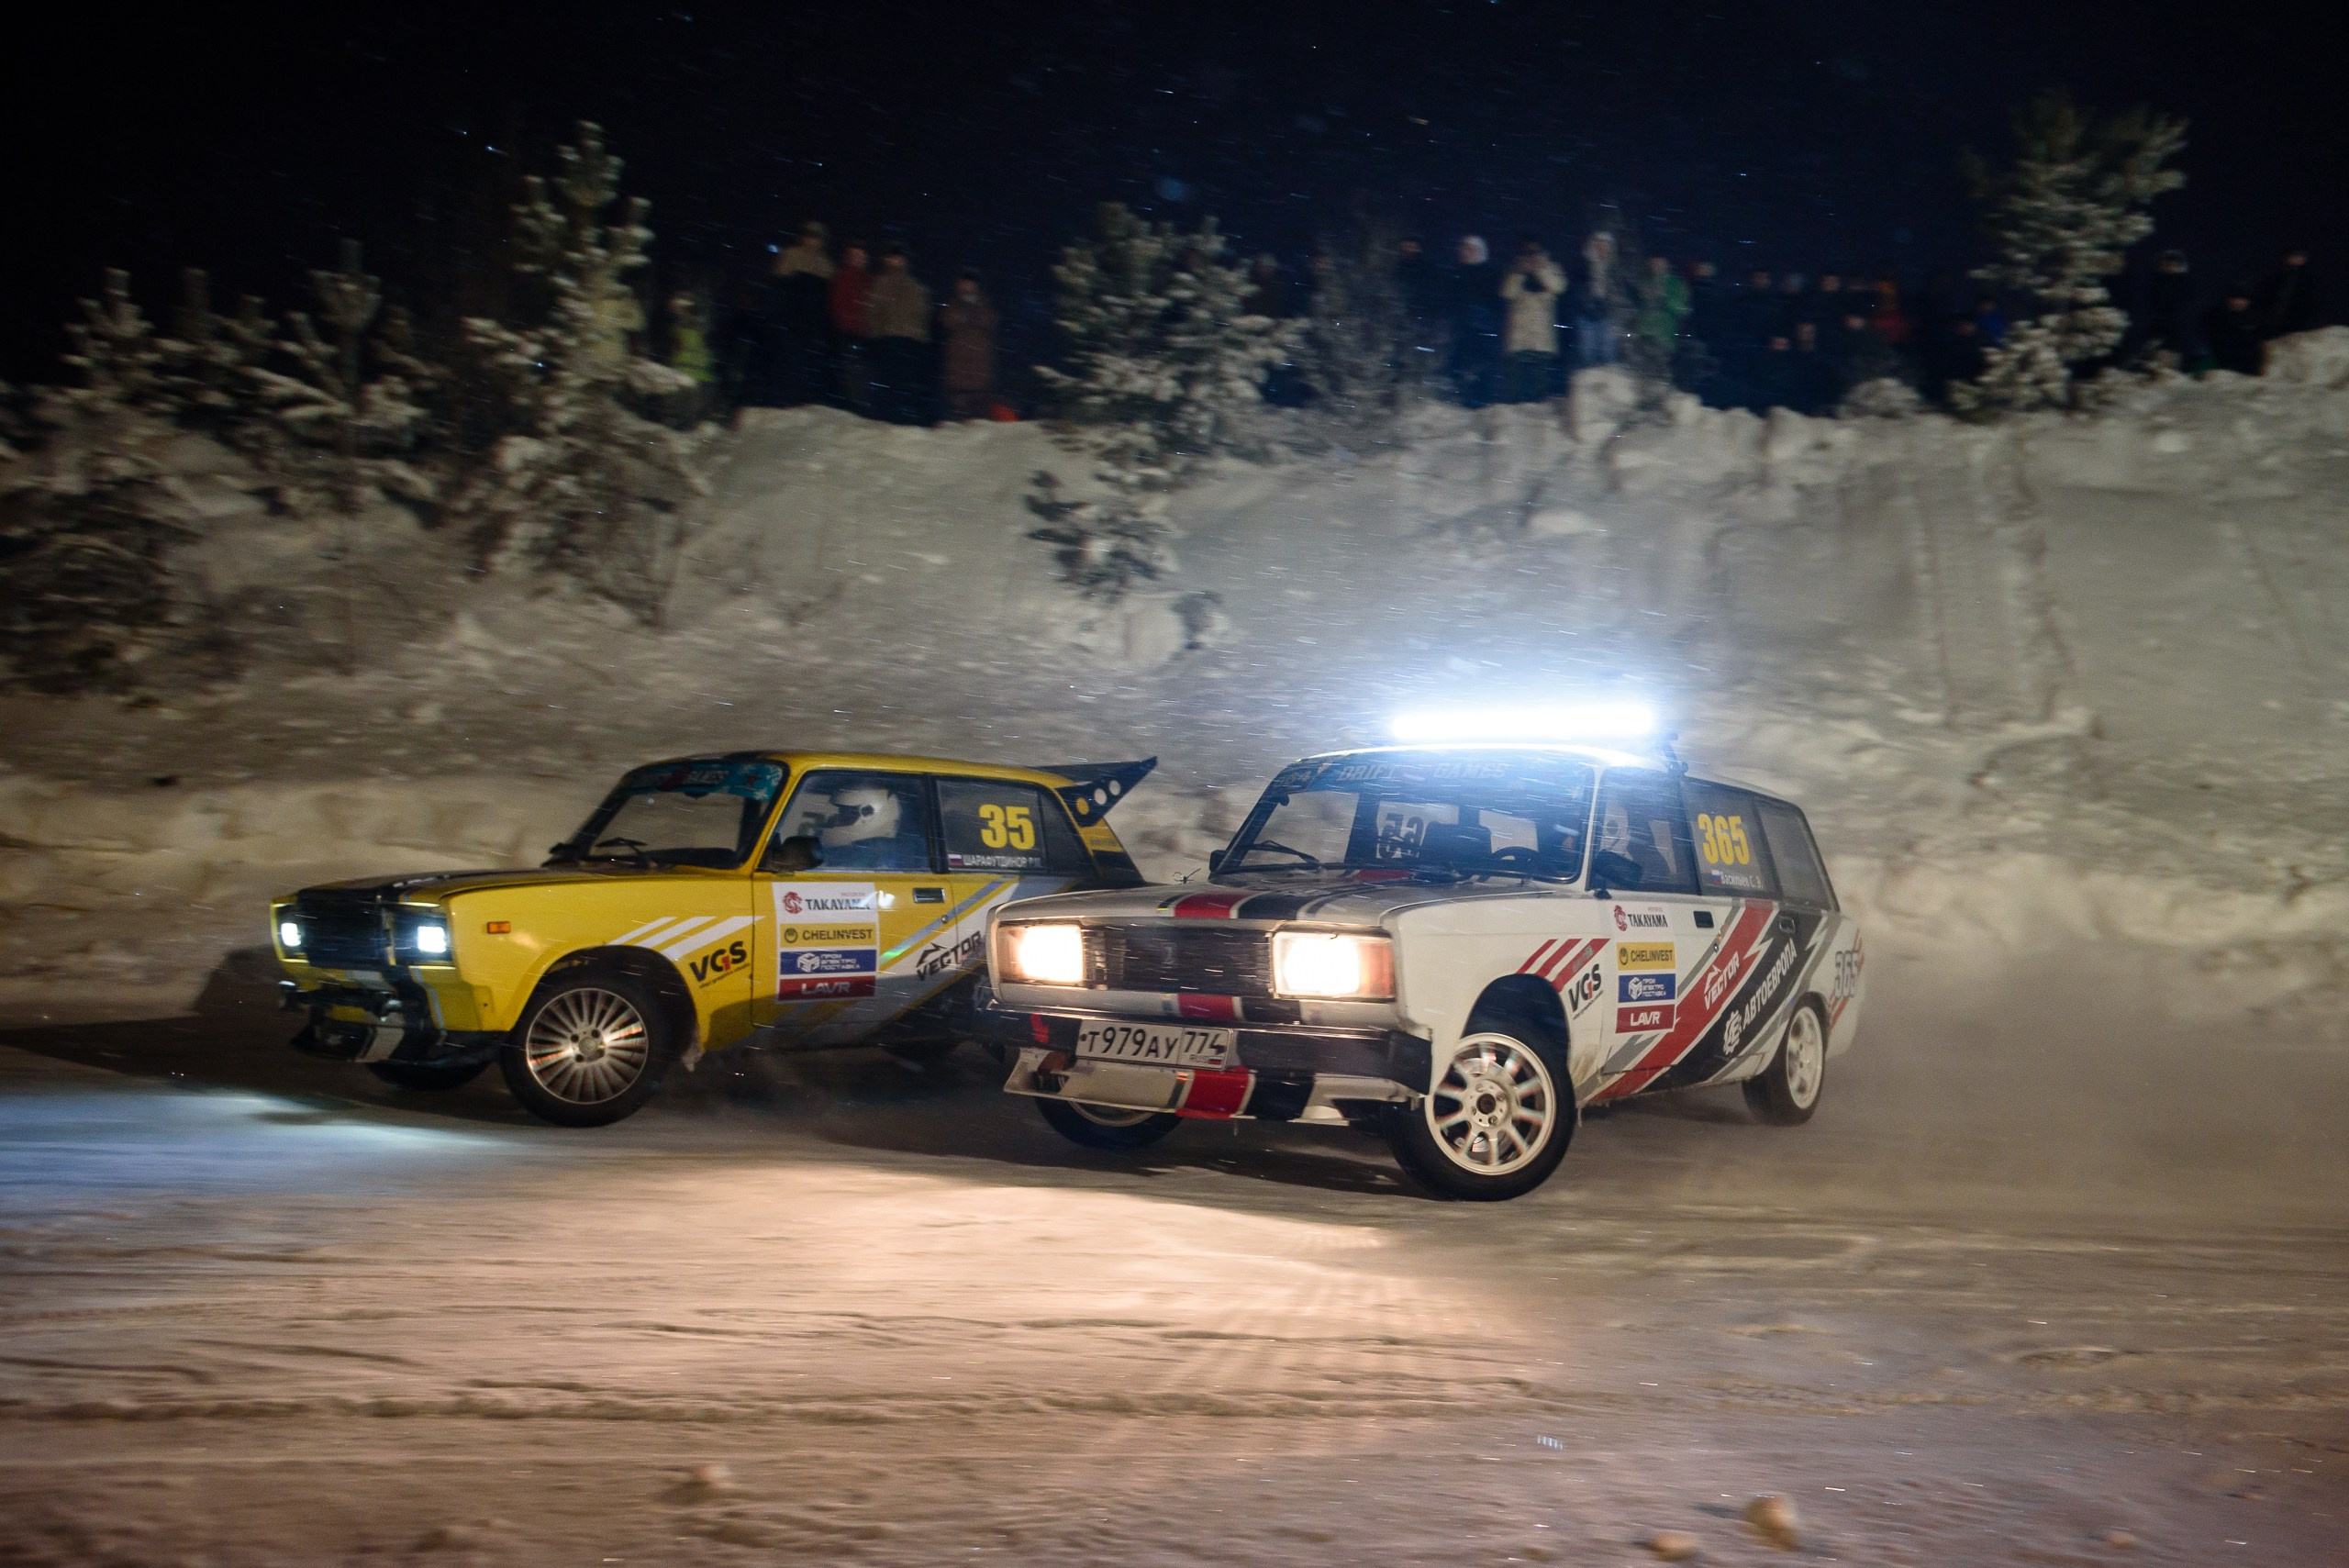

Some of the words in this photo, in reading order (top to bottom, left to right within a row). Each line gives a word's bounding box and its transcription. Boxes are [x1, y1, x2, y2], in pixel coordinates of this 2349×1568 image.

[978, 804, 1035, 851] 35
[1698, 813, 1750, 866] 365
[802, 929, 874, 941] CHELINVEST
[1627, 914, 1669, 928] TAKAYAMA
[689, 940, 748, 983] VGS
[917, 931, 986, 982] VECTOR
[1630, 950, 1674, 962] CHELINVEST
[801, 982, 852, 995] LAVR
[1567, 963, 1602, 1013] VGS
[1704, 951, 1740, 1010] VECTOR
[1742, 937, 1798, 1031] АВТОЕВРОПА
[1630, 1011, 1661, 1027] LAVR
